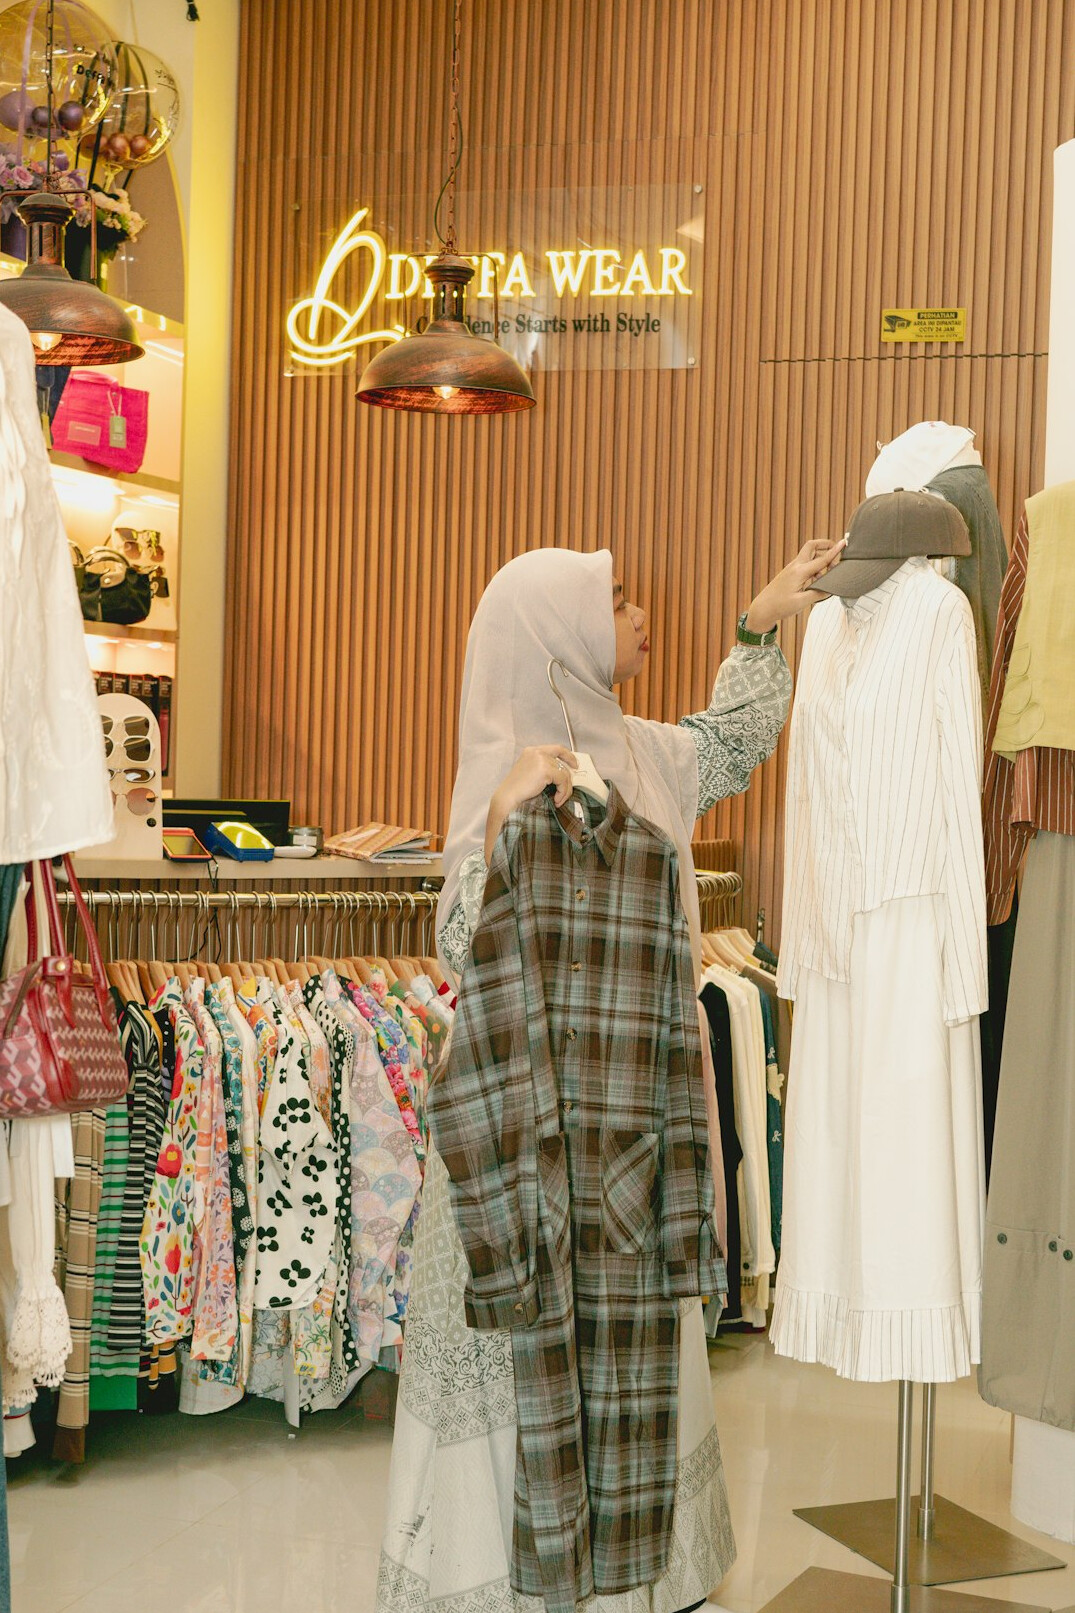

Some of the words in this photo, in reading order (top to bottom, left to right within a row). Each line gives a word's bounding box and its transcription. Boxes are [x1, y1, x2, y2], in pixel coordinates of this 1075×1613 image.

[545, 248, 693, 298] WEAR
[515, 313, 567, 334] Starts
[572, 312, 610, 332] with
[616, 312, 661, 337] Style
